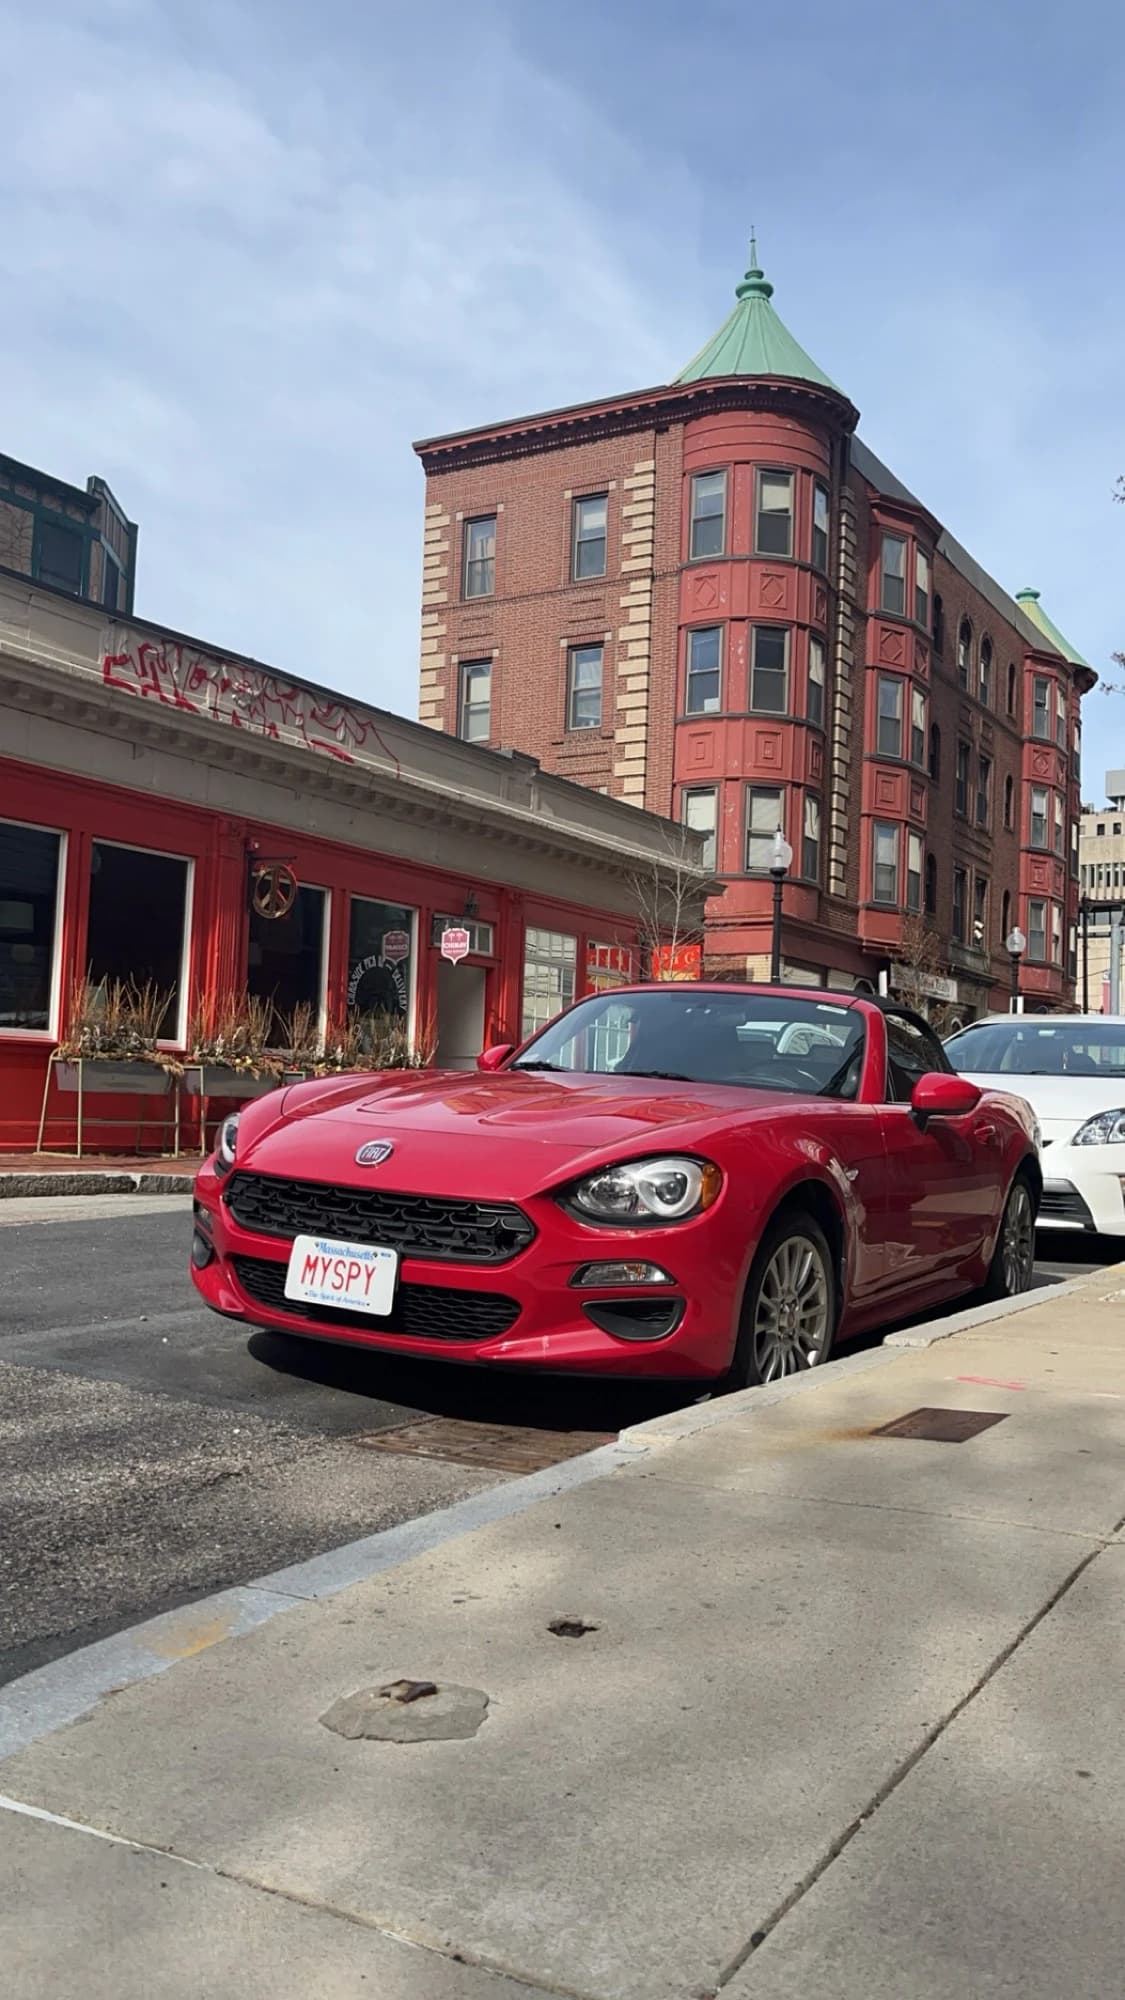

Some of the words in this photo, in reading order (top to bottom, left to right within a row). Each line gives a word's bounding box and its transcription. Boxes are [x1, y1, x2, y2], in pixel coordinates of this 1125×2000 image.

[361, 1146, 387, 1160] FIAT
[319, 1241, 375, 1261] Massachusetts
[300, 1254, 376, 1296] MYSPY
